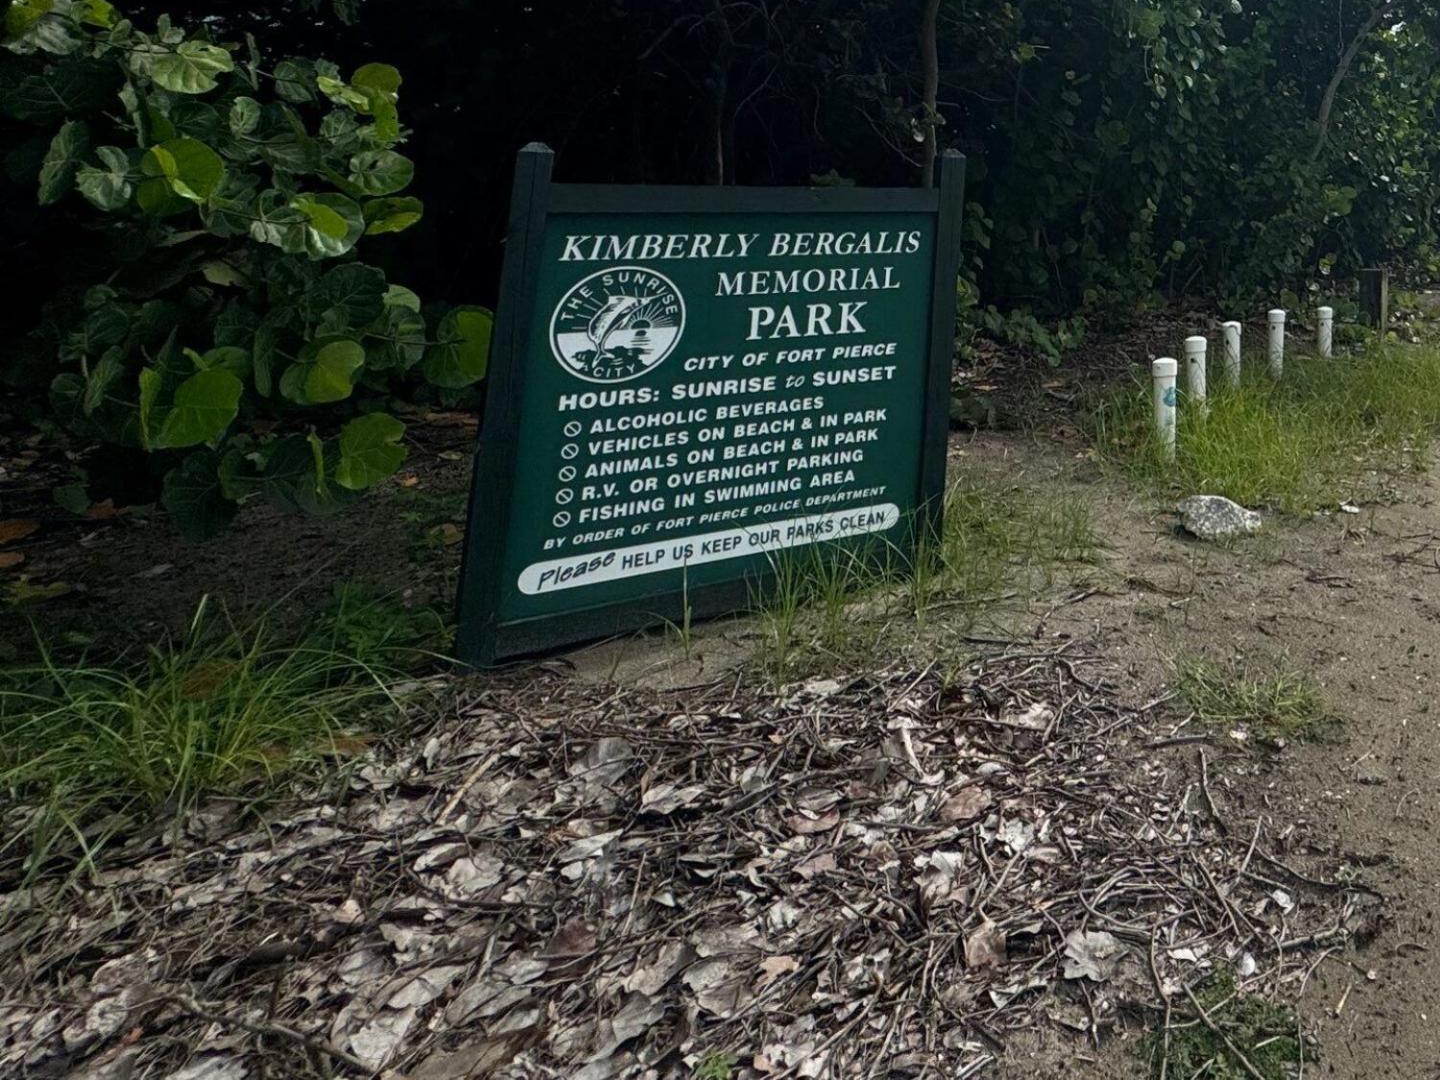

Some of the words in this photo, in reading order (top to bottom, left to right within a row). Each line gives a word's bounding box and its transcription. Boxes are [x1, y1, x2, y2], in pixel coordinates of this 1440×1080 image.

[558, 233, 759, 261] KIMBERLY
[768, 231, 921, 257] BERGALIS
[561, 286, 593, 320] THE
[602, 272, 678, 315] SUNRISE
[715, 267, 900, 296] MEMORIAL
[746, 302, 867, 340] PARK
[593, 363, 635, 378] CITY
[684, 355, 734, 371] CITY
[742, 352, 768, 366] OF
[776, 348, 825, 364] FORT
[833, 343, 897, 359] PIERCE
[558, 387, 660, 411] HOURS:
[672, 376, 776, 400] SUNRISE
[786, 374, 805, 389] to
[812, 366, 896, 387] SUNSET
[588, 431, 688, 455] VEHICLES
[698, 427, 725, 442] ON
[734, 419, 795, 438] BEACH
[801, 417, 812, 430] &
[820, 415, 837, 428] IN
[844, 409, 887, 425] PARK
[590, 409, 707, 433] ALCOHOLIC
[716, 396, 824, 420] BEVERAGES
[581, 483, 619, 500] R.V.
[630, 477, 658, 493] OR
[667, 461, 779, 488] OVERNIGHT
[787, 449, 863, 471] PARKING
[585, 453, 678, 478] ANIMALS
[687, 449, 714, 464] ON
[723, 440, 785, 460] BEACH
[791, 438, 803, 451] &
[811, 435, 828, 448] IN
[835, 428, 878, 445] PARK
[543, 537, 566, 550] BY
[572, 528, 624, 545] ORDER
[631, 522, 651, 535] OF
[656, 516, 694, 531] FORT
[699, 508, 749, 524] PIERCE
[754, 499, 800, 515] POLICE
[805, 486, 886, 507] DEPARTMENT
[579, 498, 664, 523] FISHING
[675, 493, 695, 508] IN
[704, 477, 801, 503] SWIMMING
[809, 470, 855, 488] AREA
[537, 552, 615, 591] Please
[622, 549, 665, 569] HELP
[672, 544, 694, 560] US
[701, 536, 742, 555] KEEP
[749, 529, 780, 546] OUR
[787, 519, 833, 540] PARKS
[840, 511, 885, 530] CLEAN
